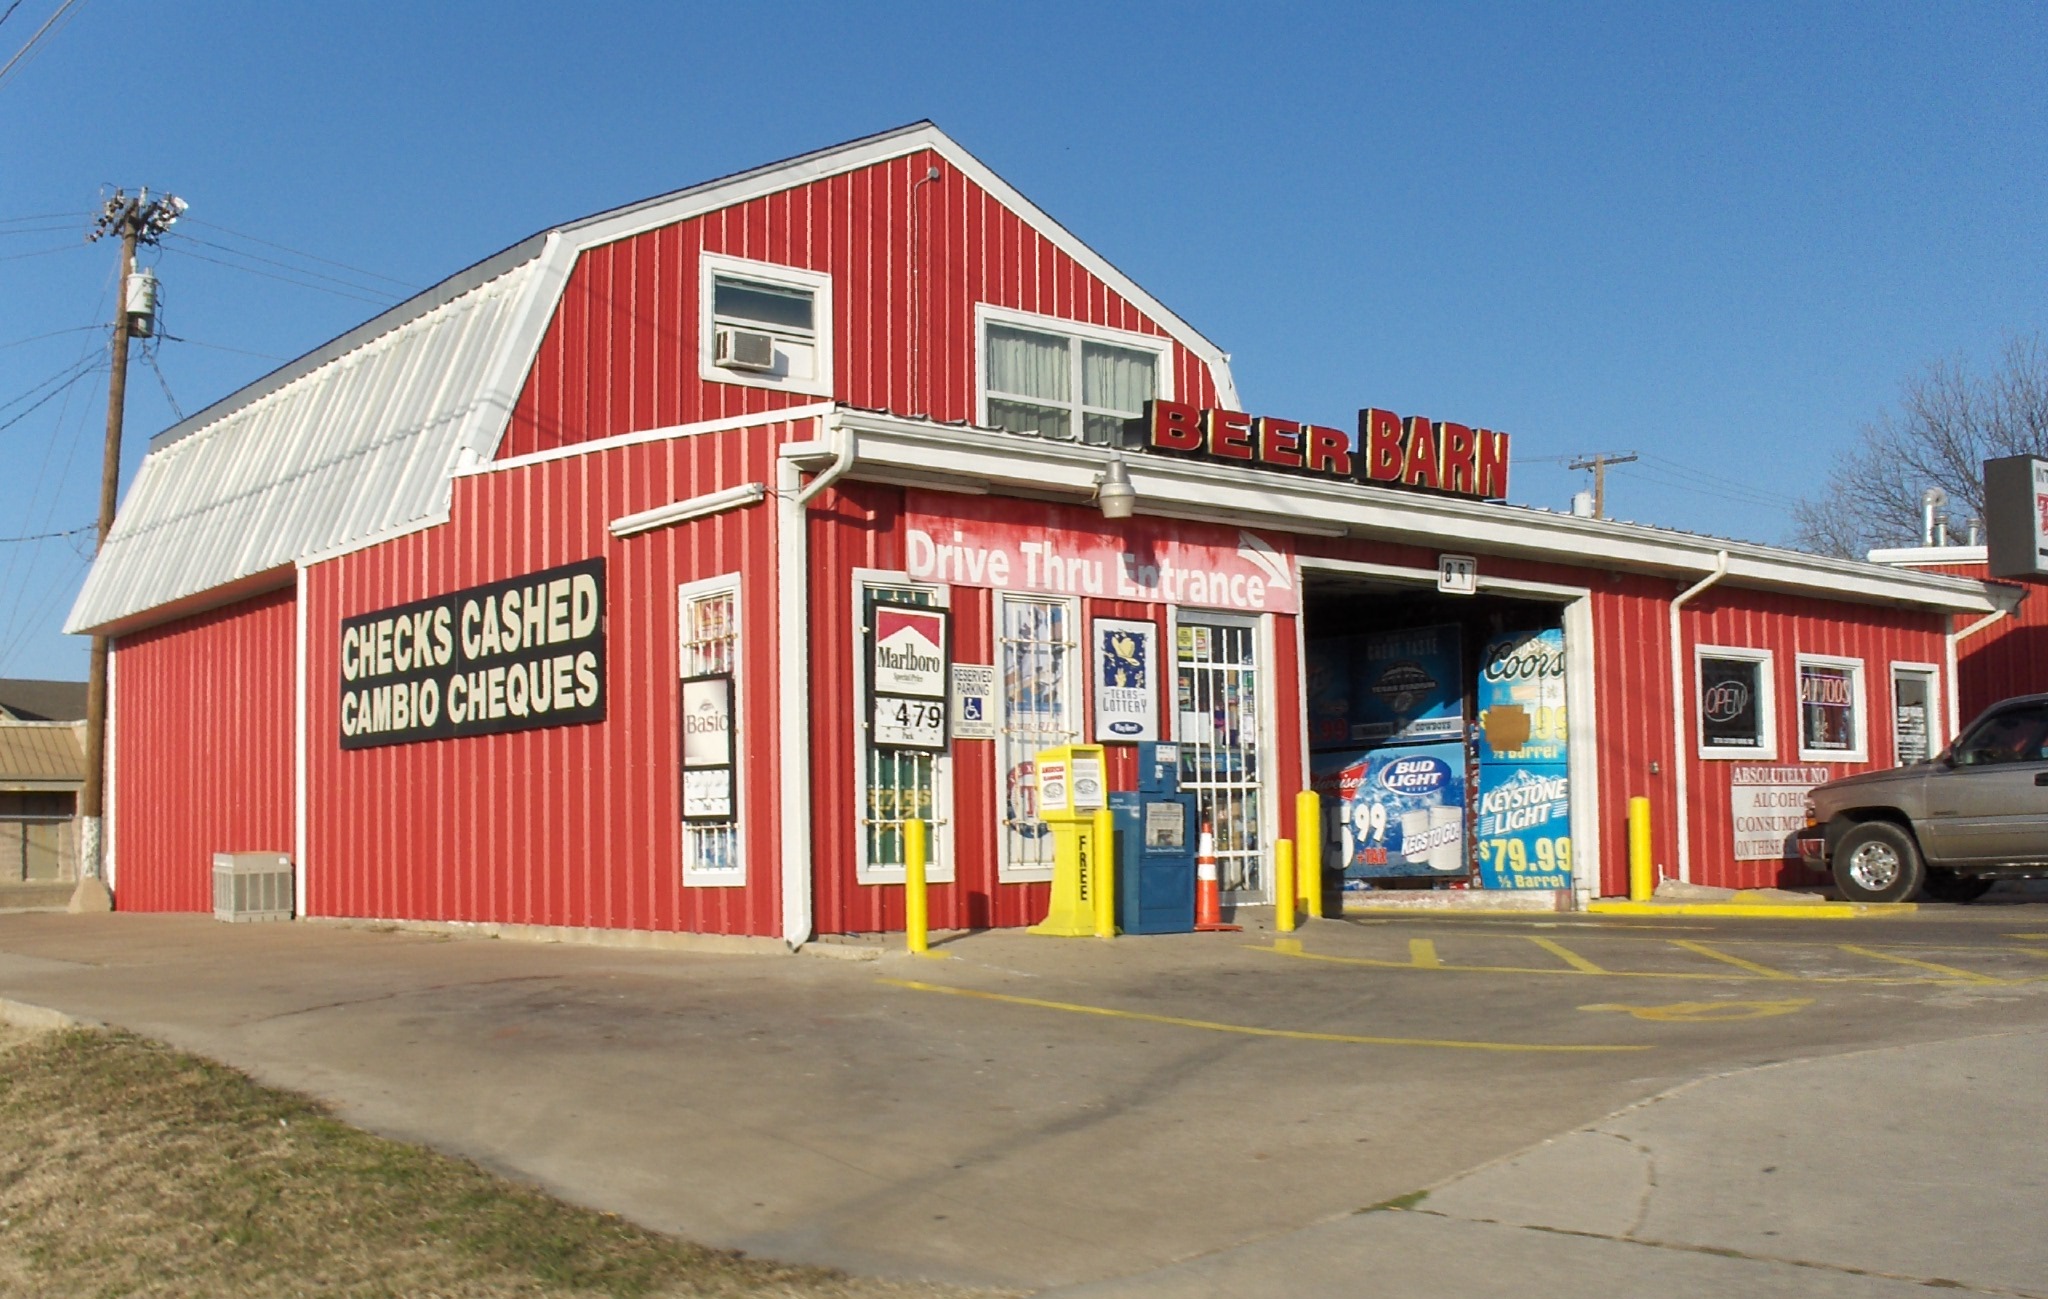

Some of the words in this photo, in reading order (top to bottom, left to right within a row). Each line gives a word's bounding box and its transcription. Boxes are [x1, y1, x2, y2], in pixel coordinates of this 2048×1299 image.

[1151, 399, 1350, 475] BEER
[1366, 408, 1509, 498] BARN
[906, 530, 1009, 586] Drive
[1019, 541, 1104, 594] Thru
[1117, 552, 1265, 608] Entrance
[342, 606, 452, 681] CHECKS
[461, 573, 598, 660] CASHED
[877, 643, 940, 673] Marlboro
[1485, 642, 1564, 680] Coors
[954, 668, 992, 682] RESERVED
[341, 678, 440, 737] CAMBIO
[447, 651, 599, 725] CHEQUES
[957, 682, 990, 696] PARKING
[1111, 689, 1137, 699] TEXAS
[1705, 687, 1745, 714] OPEN
[1801, 677, 1850, 703] ATTOOS
[1103, 697, 1147, 713] LOTTERY
[686, 711, 729, 734] Basic
[1415, 720, 1452, 732] COWBOYS
[1508, 745, 1558, 759] Barrel
[1395, 760, 1435, 774] BUD
[1733, 766, 1808, 783] ABSOLUTELY
[1810, 767, 1829, 783] NO
[1387, 773, 1441, 787] LIGHT
[1480, 778, 1568, 815] KEYSTONE
[1752, 792, 1807, 807] ALCOHO
[1494, 803, 1552, 834] LIGHT
[1736, 816, 1807, 832] CONSUMPT
[1402, 832, 1428, 857] KEGS
[1429, 827, 1442, 848] TO
[1736, 841, 1750, 856] ON
[1752, 839, 1782, 855] THESE
[1479, 837, 1571, 872] $79.99
[1079, 835, 1087, 901] FREE
[1514, 874, 1566, 888] Barrel
